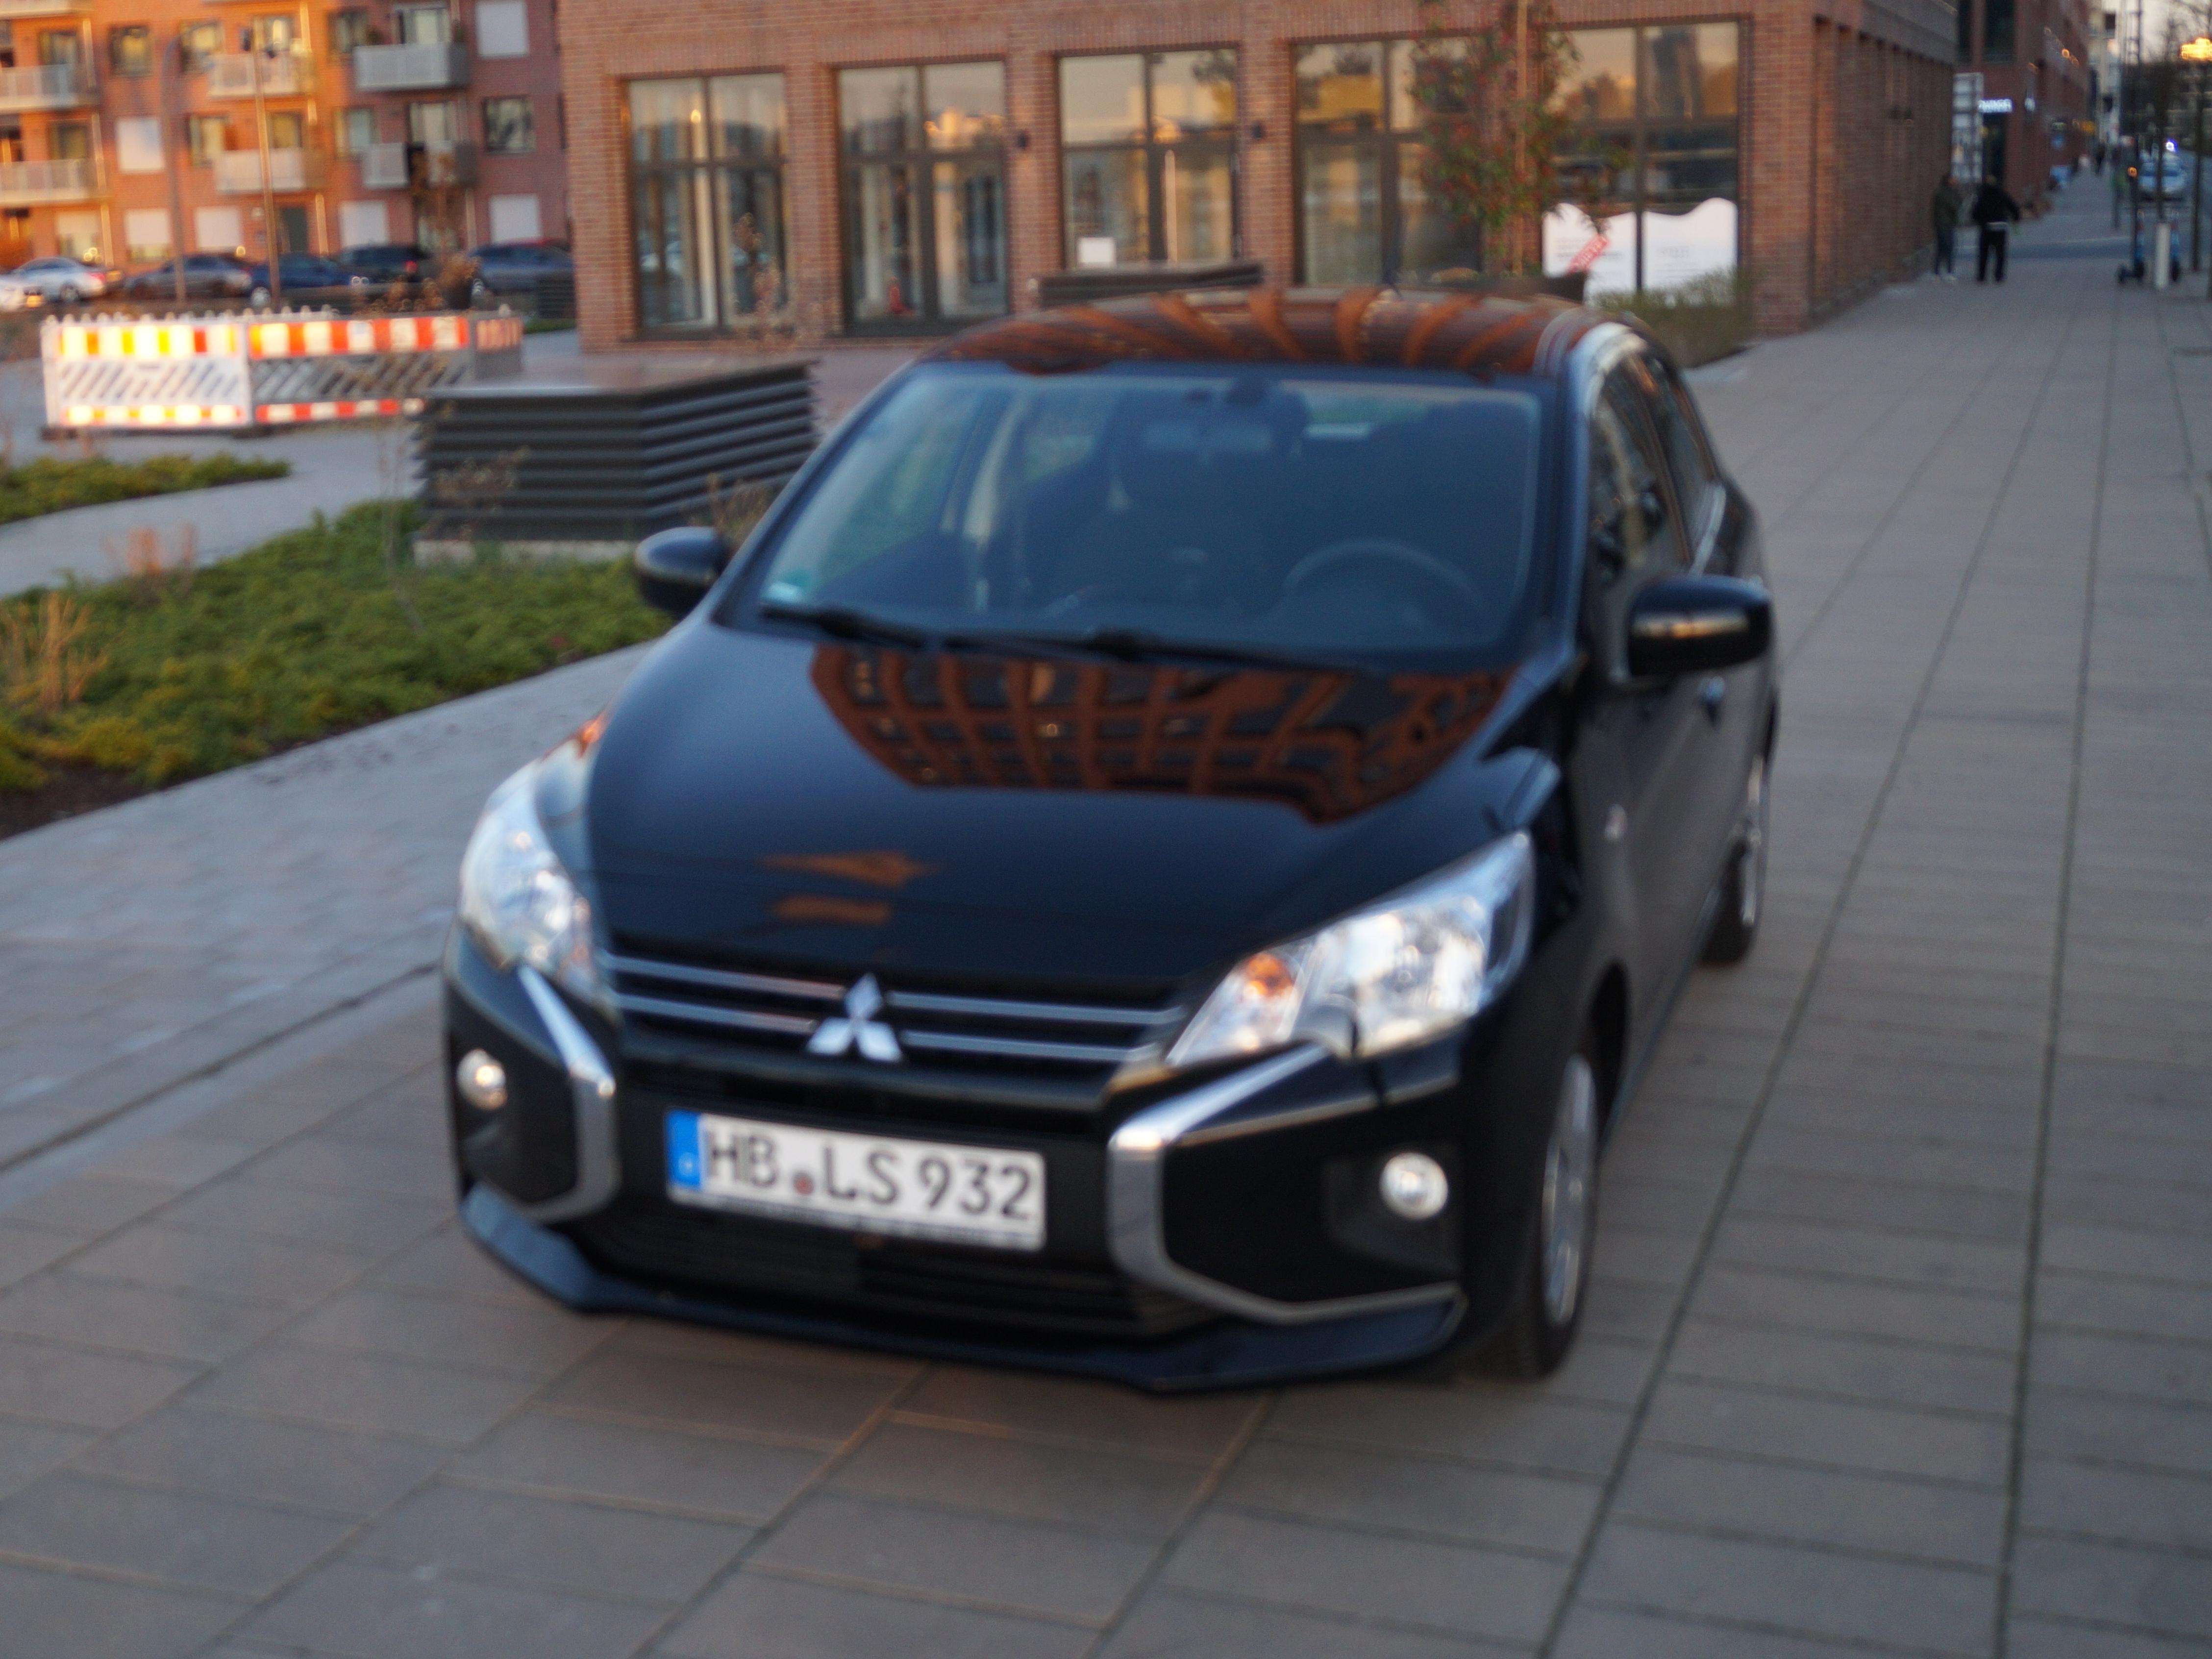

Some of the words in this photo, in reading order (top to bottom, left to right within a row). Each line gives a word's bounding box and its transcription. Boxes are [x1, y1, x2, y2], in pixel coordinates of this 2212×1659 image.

[705, 1130, 778, 1189] HB
[823, 1146, 898, 1205] LS
[918, 1157, 1030, 1221] 932
